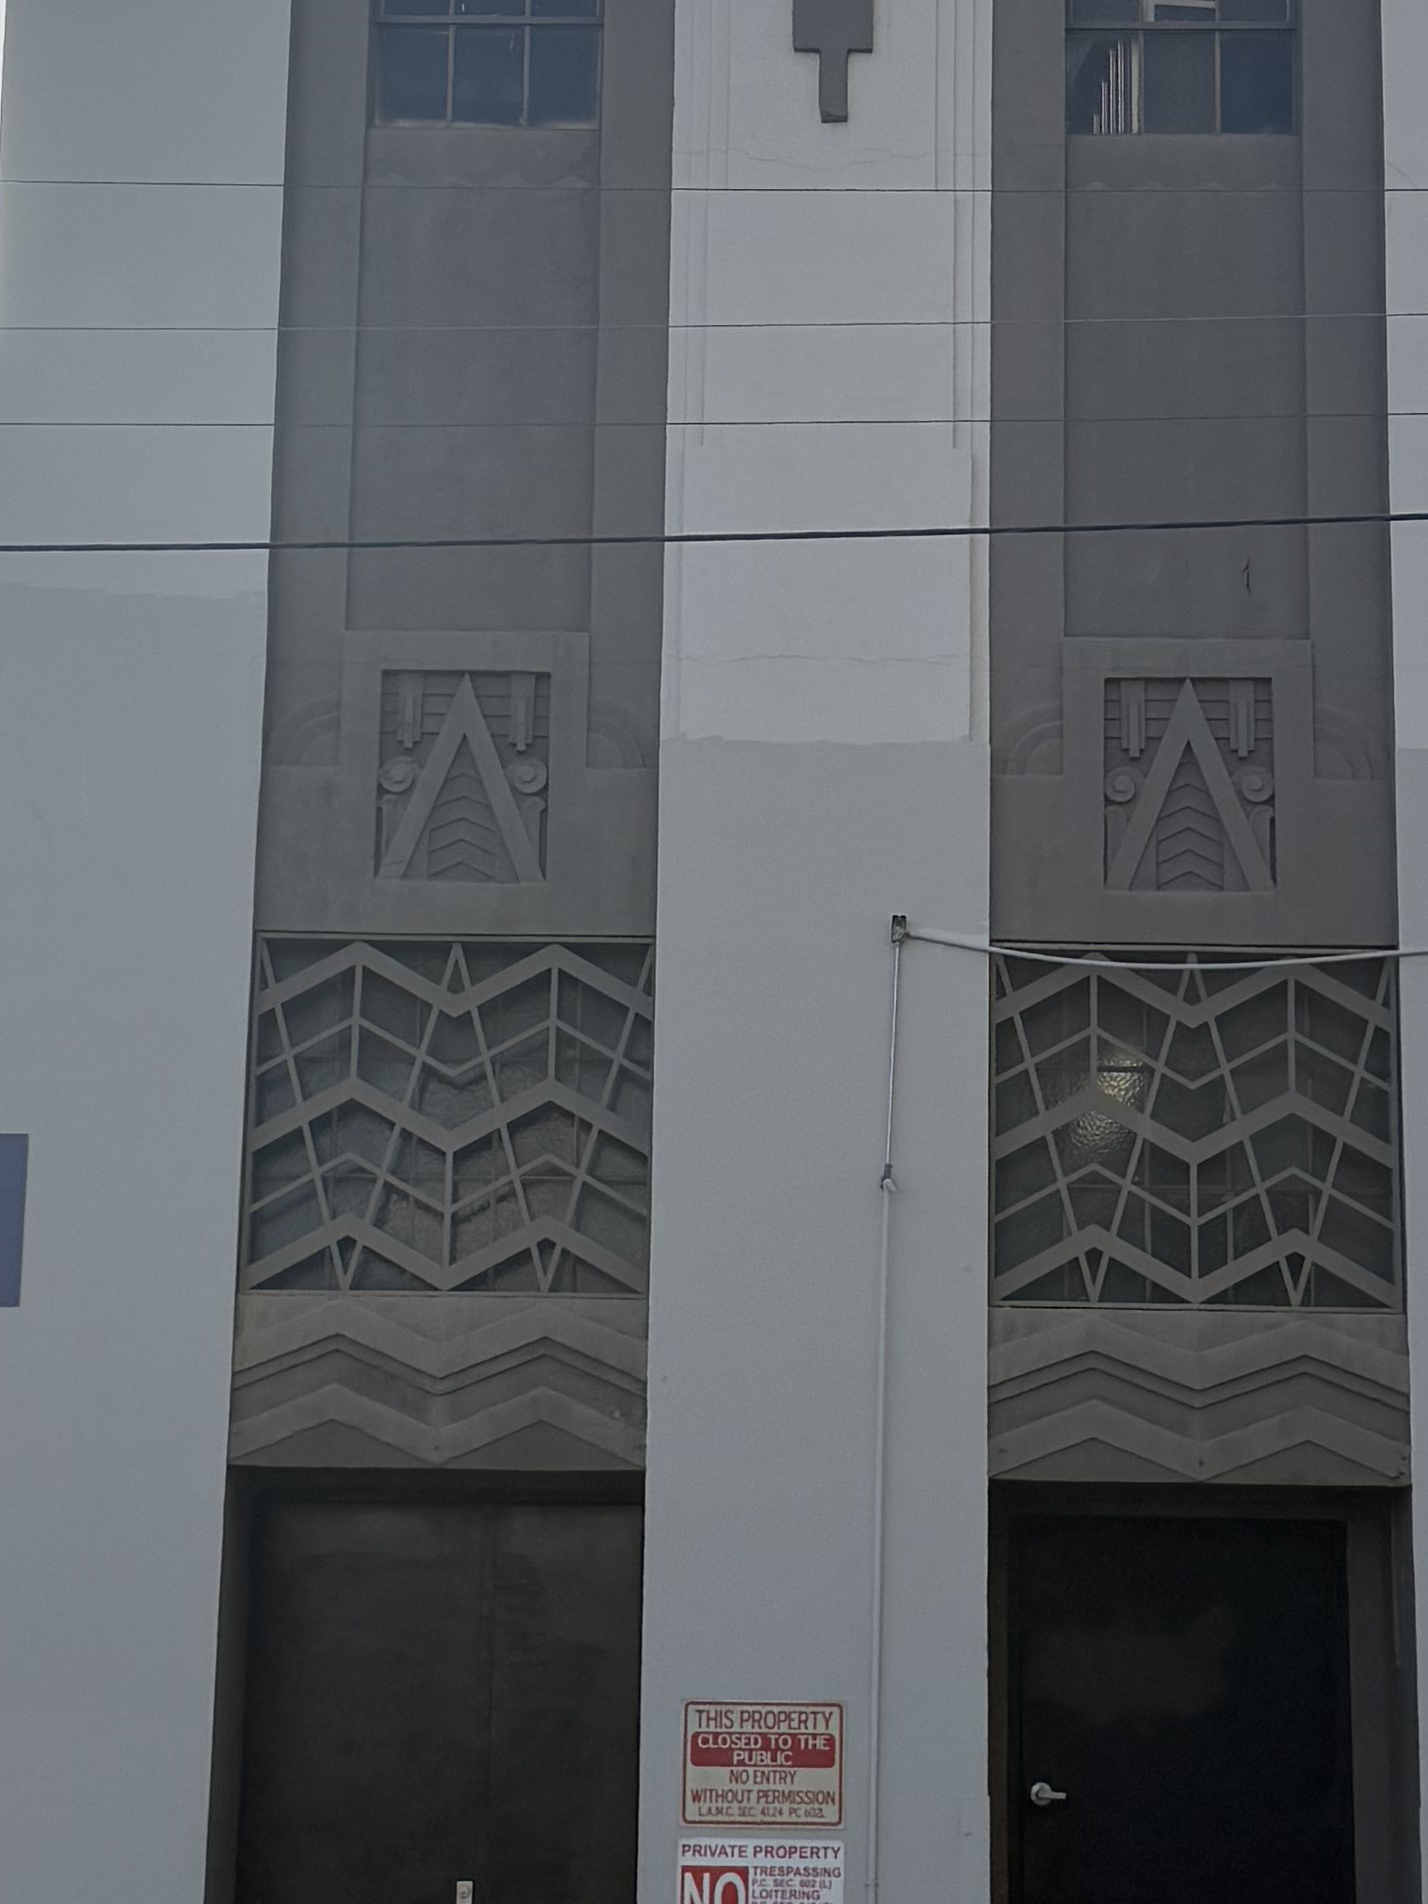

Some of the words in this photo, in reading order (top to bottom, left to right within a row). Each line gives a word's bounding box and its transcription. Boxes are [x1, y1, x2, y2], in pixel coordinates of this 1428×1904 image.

[694, 1709, 735, 1730] THIS
[739, 1710, 834, 1731] PROPERTY
[697, 1733, 763, 1749] CLOSED
[770, 1734, 793, 1749] TO
[796, 1734, 831, 1751] THE
[732, 1750, 793, 1766] PUBLIC
[728, 1769, 749, 1785] NO
[753, 1769, 797, 1786] ENTRY
[690, 1788, 754, 1805] WITHOUT
[756, 1789, 836, 1806] PERMISSION
[680, 1844, 748, 1859] PRIVATE
[752, 1845, 841, 1860] PROPERTY
[752, 1866, 842, 1878] TRESPASSING
[752, 1889, 821, 1901] LOITERING
